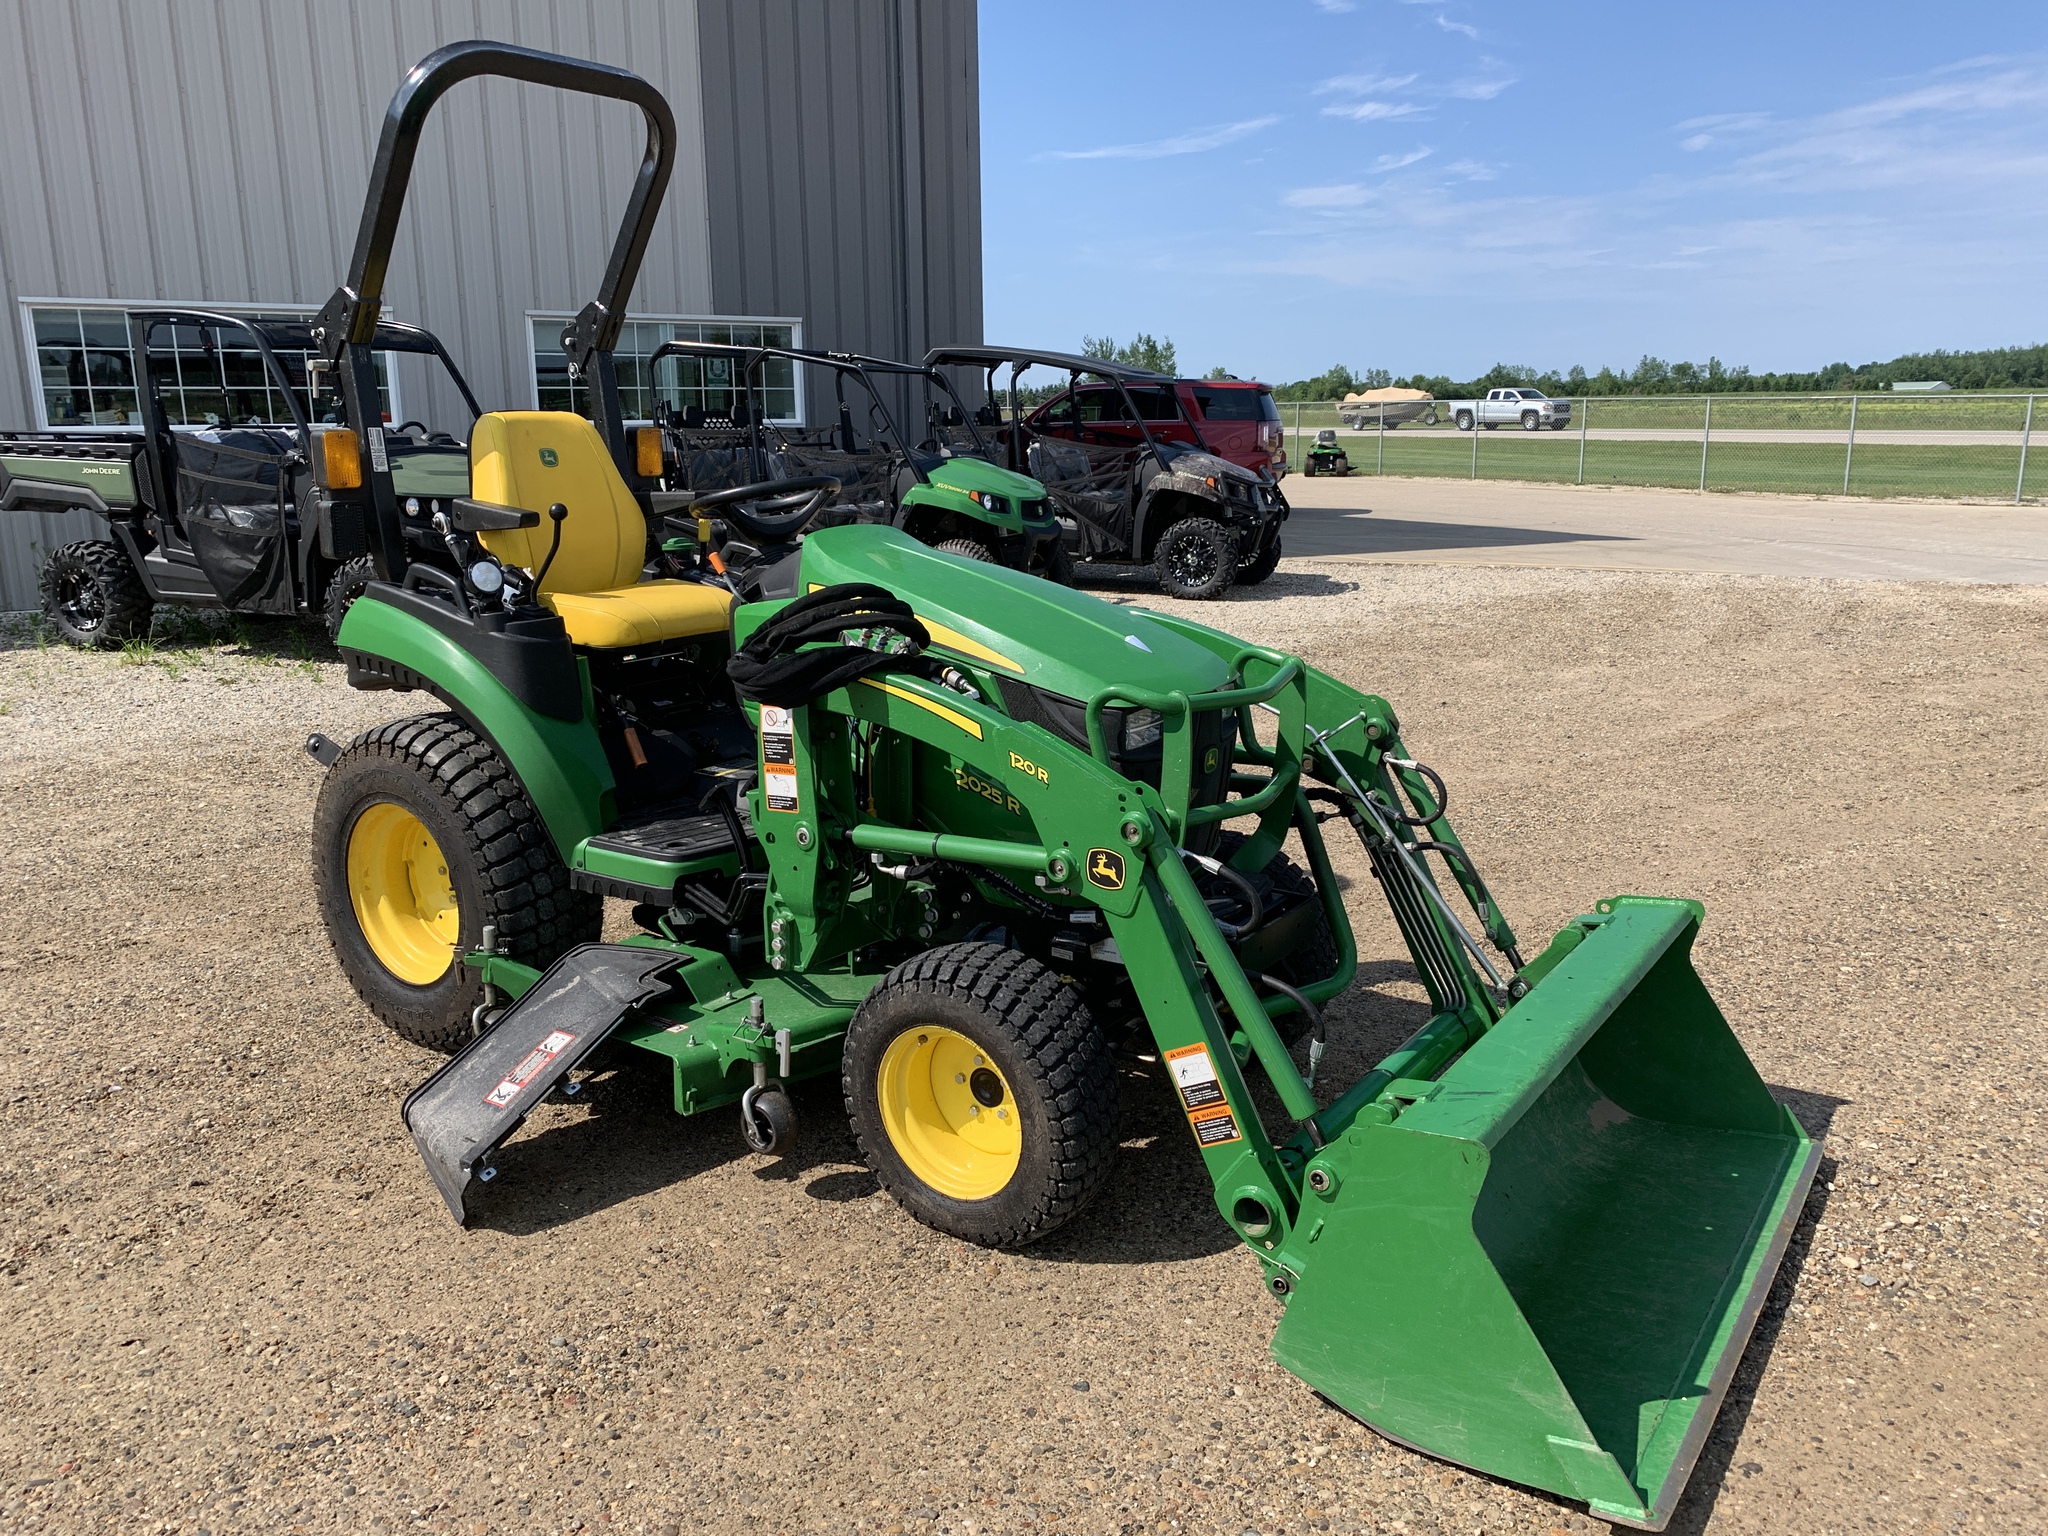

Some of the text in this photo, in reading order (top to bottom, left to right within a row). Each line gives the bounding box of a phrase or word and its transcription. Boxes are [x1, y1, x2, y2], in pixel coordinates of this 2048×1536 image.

[81, 466, 121, 475] JOHN DEERE
[771, 767, 796, 775] WARNING
[954, 768, 1004, 806] 2025
[1176, 1045, 1203, 1057] WARNING
[1201, 1108, 1228, 1119] WARNING
